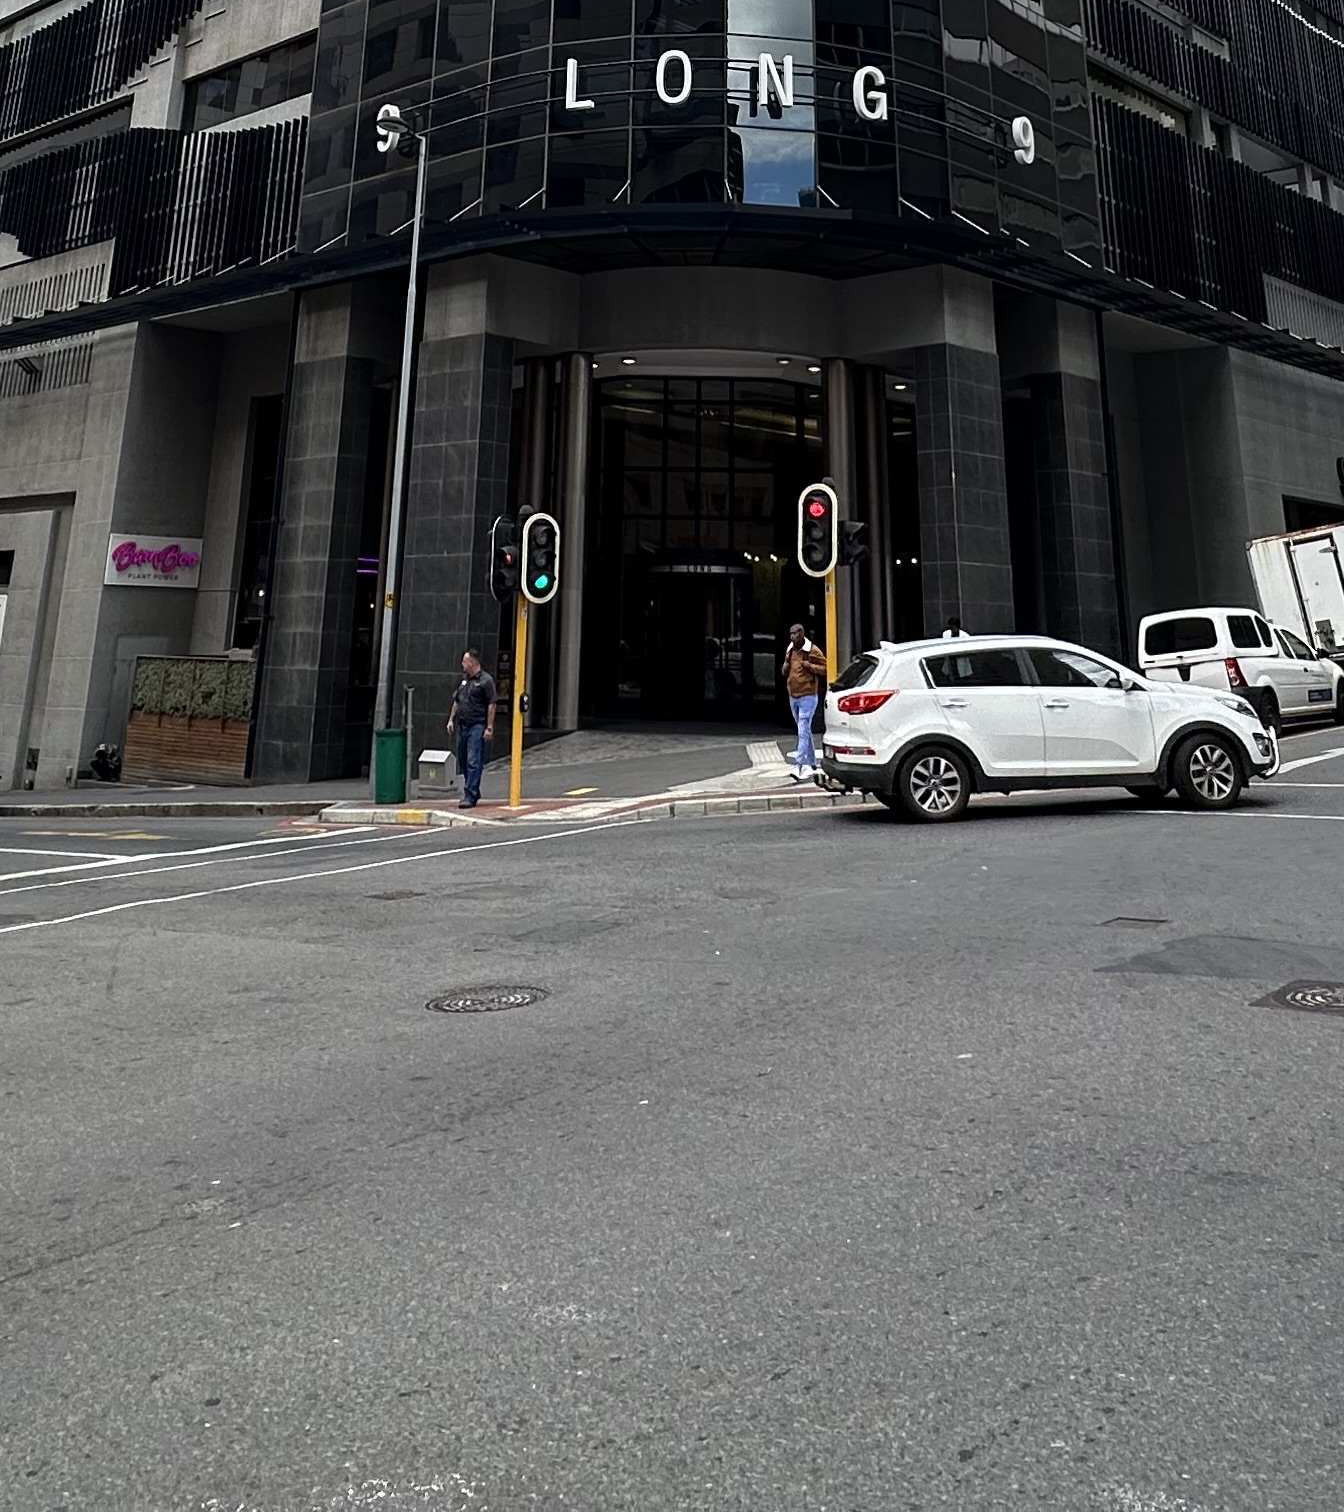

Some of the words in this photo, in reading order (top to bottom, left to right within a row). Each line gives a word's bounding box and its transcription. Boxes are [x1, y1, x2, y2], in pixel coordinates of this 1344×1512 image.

[565, 49, 889, 122] LONG
[1011, 115, 1035, 165] 9
[153, 573, 179, 581] POWER
